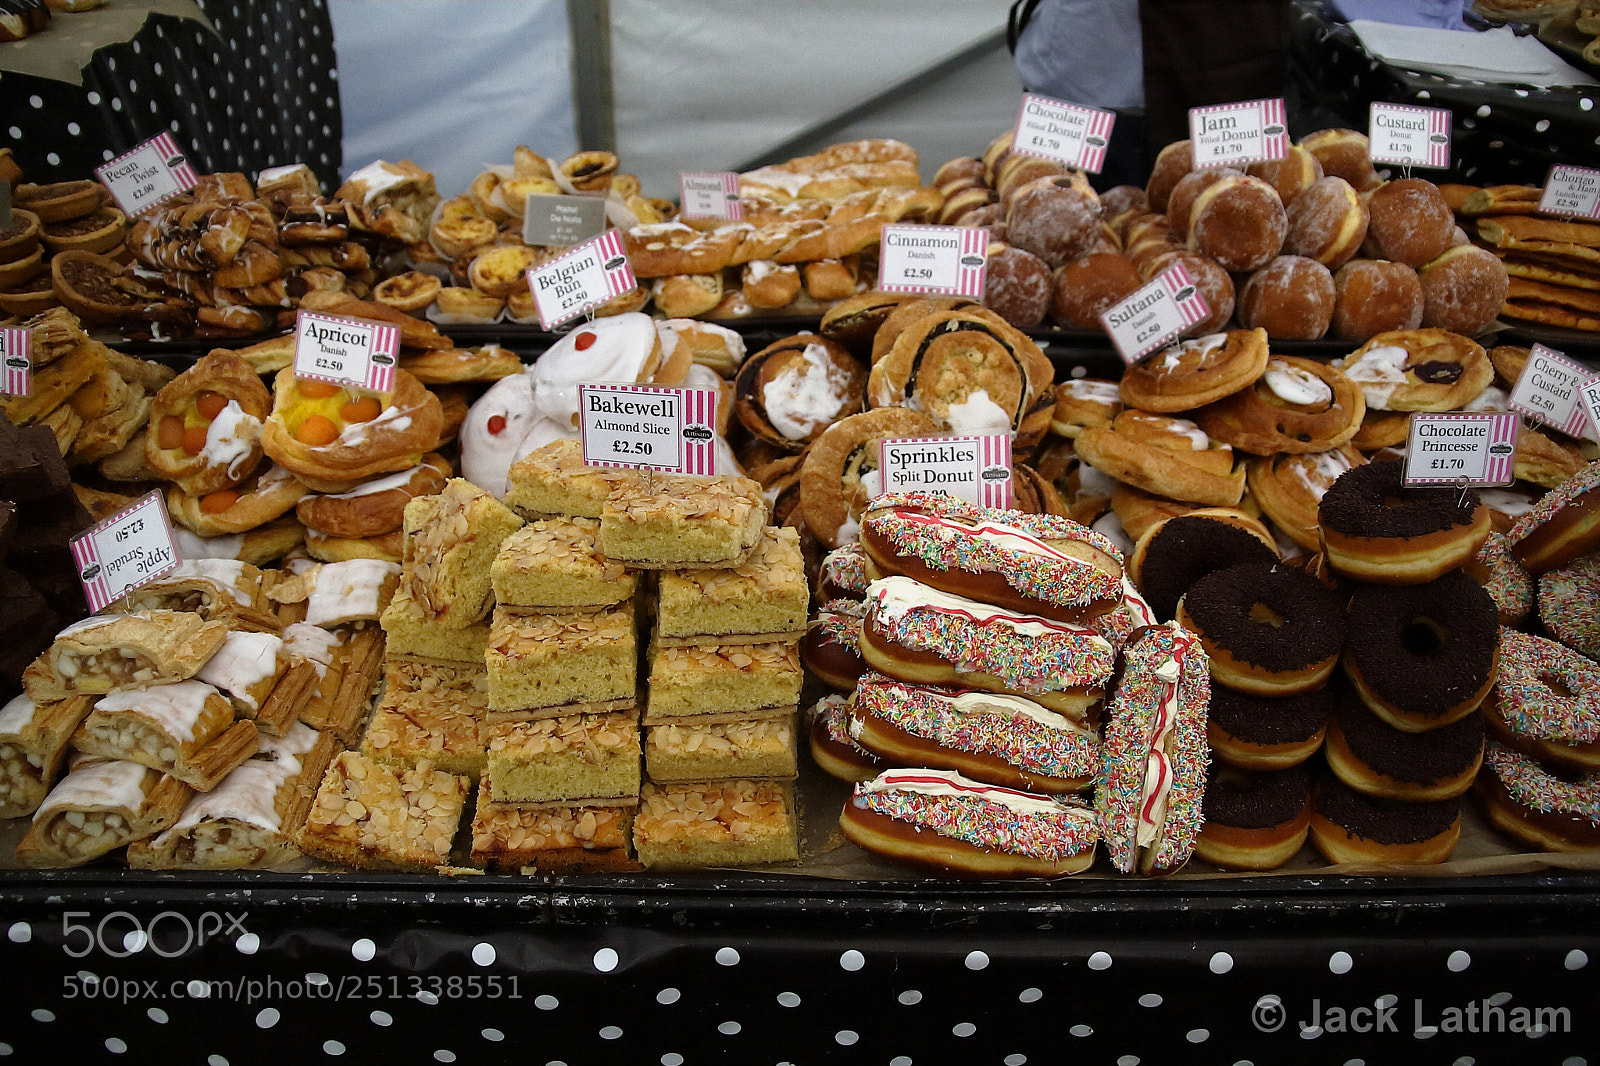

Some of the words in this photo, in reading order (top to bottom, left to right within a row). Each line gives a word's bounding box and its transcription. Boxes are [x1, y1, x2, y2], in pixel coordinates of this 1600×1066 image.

[1027, 103, 1085, 125] Chocolate
[1376, 114, 1425, 131] Custard
[1047, 122, 1083, 139] Donut
[1199, 116, 1237, 135] Jam
[1032, 136, 1060, 149] £1.70
[1200, 135, 1221, 144] Filled
[1222, 129, 1259, 141] Donut
[1390, 130, 1412, 139] Donut
[1213, 144, 1242, 155] £1.70
[1389, 143, 1412, 152] £1.70
[105, 161, 139, 182] Pecan
[129, 166, 159, 184] Twist
[1553, 171, 1595, 185] Chorizo
[133, 183, 154, 199] £2.00
[1577, 184, 1597, 193] Ham
[1556, 198, 1579, 207] £2.50
[887, 233, 958, 248] Cinnamon
[907, 250, 936, 259] Danish
[537, 257, 595, 290] Belgian
[904, 268, 933, 278] £2.50
[555, 280, 582, 298] Bun
[562, 290, 588, 309] £2.50
[1108, 288, 1165, 329] Sultana
[1132, 311, 1156, 329] Danish
[304, 322, 367, 347] Apricot
[1136, 323, 1161, 343] £2.50
[320, 344, 347, 356] Danish
[315, 358, 343, 371] £2.50
[1534, 357, 1571, 386] Cherry
[1531, 373, 1572, 400] Custard
[589, 395, 674, 418] Bakewell
[1530, 394, 1555, 411] £2.50
[594, 419, 640, 433] Almond
[643, 422, 671, 435] Slice
[1419, 424, 1486, 437] Chocolate
[613, 440, 653, 455] £2.50
[1421, 440, 1478, 452] Princesse
[890, 447, 974, 470] Sprinkles
[1431, 459, 1464, 469] £1.70
[892, 471, 920, 485] Split
[923, 469, 974, 483] Donut
[115, 518, 145, 543] £2.50
[105, 546, 144, 577] Strudel
[137, 547, 171, 573] Apple
